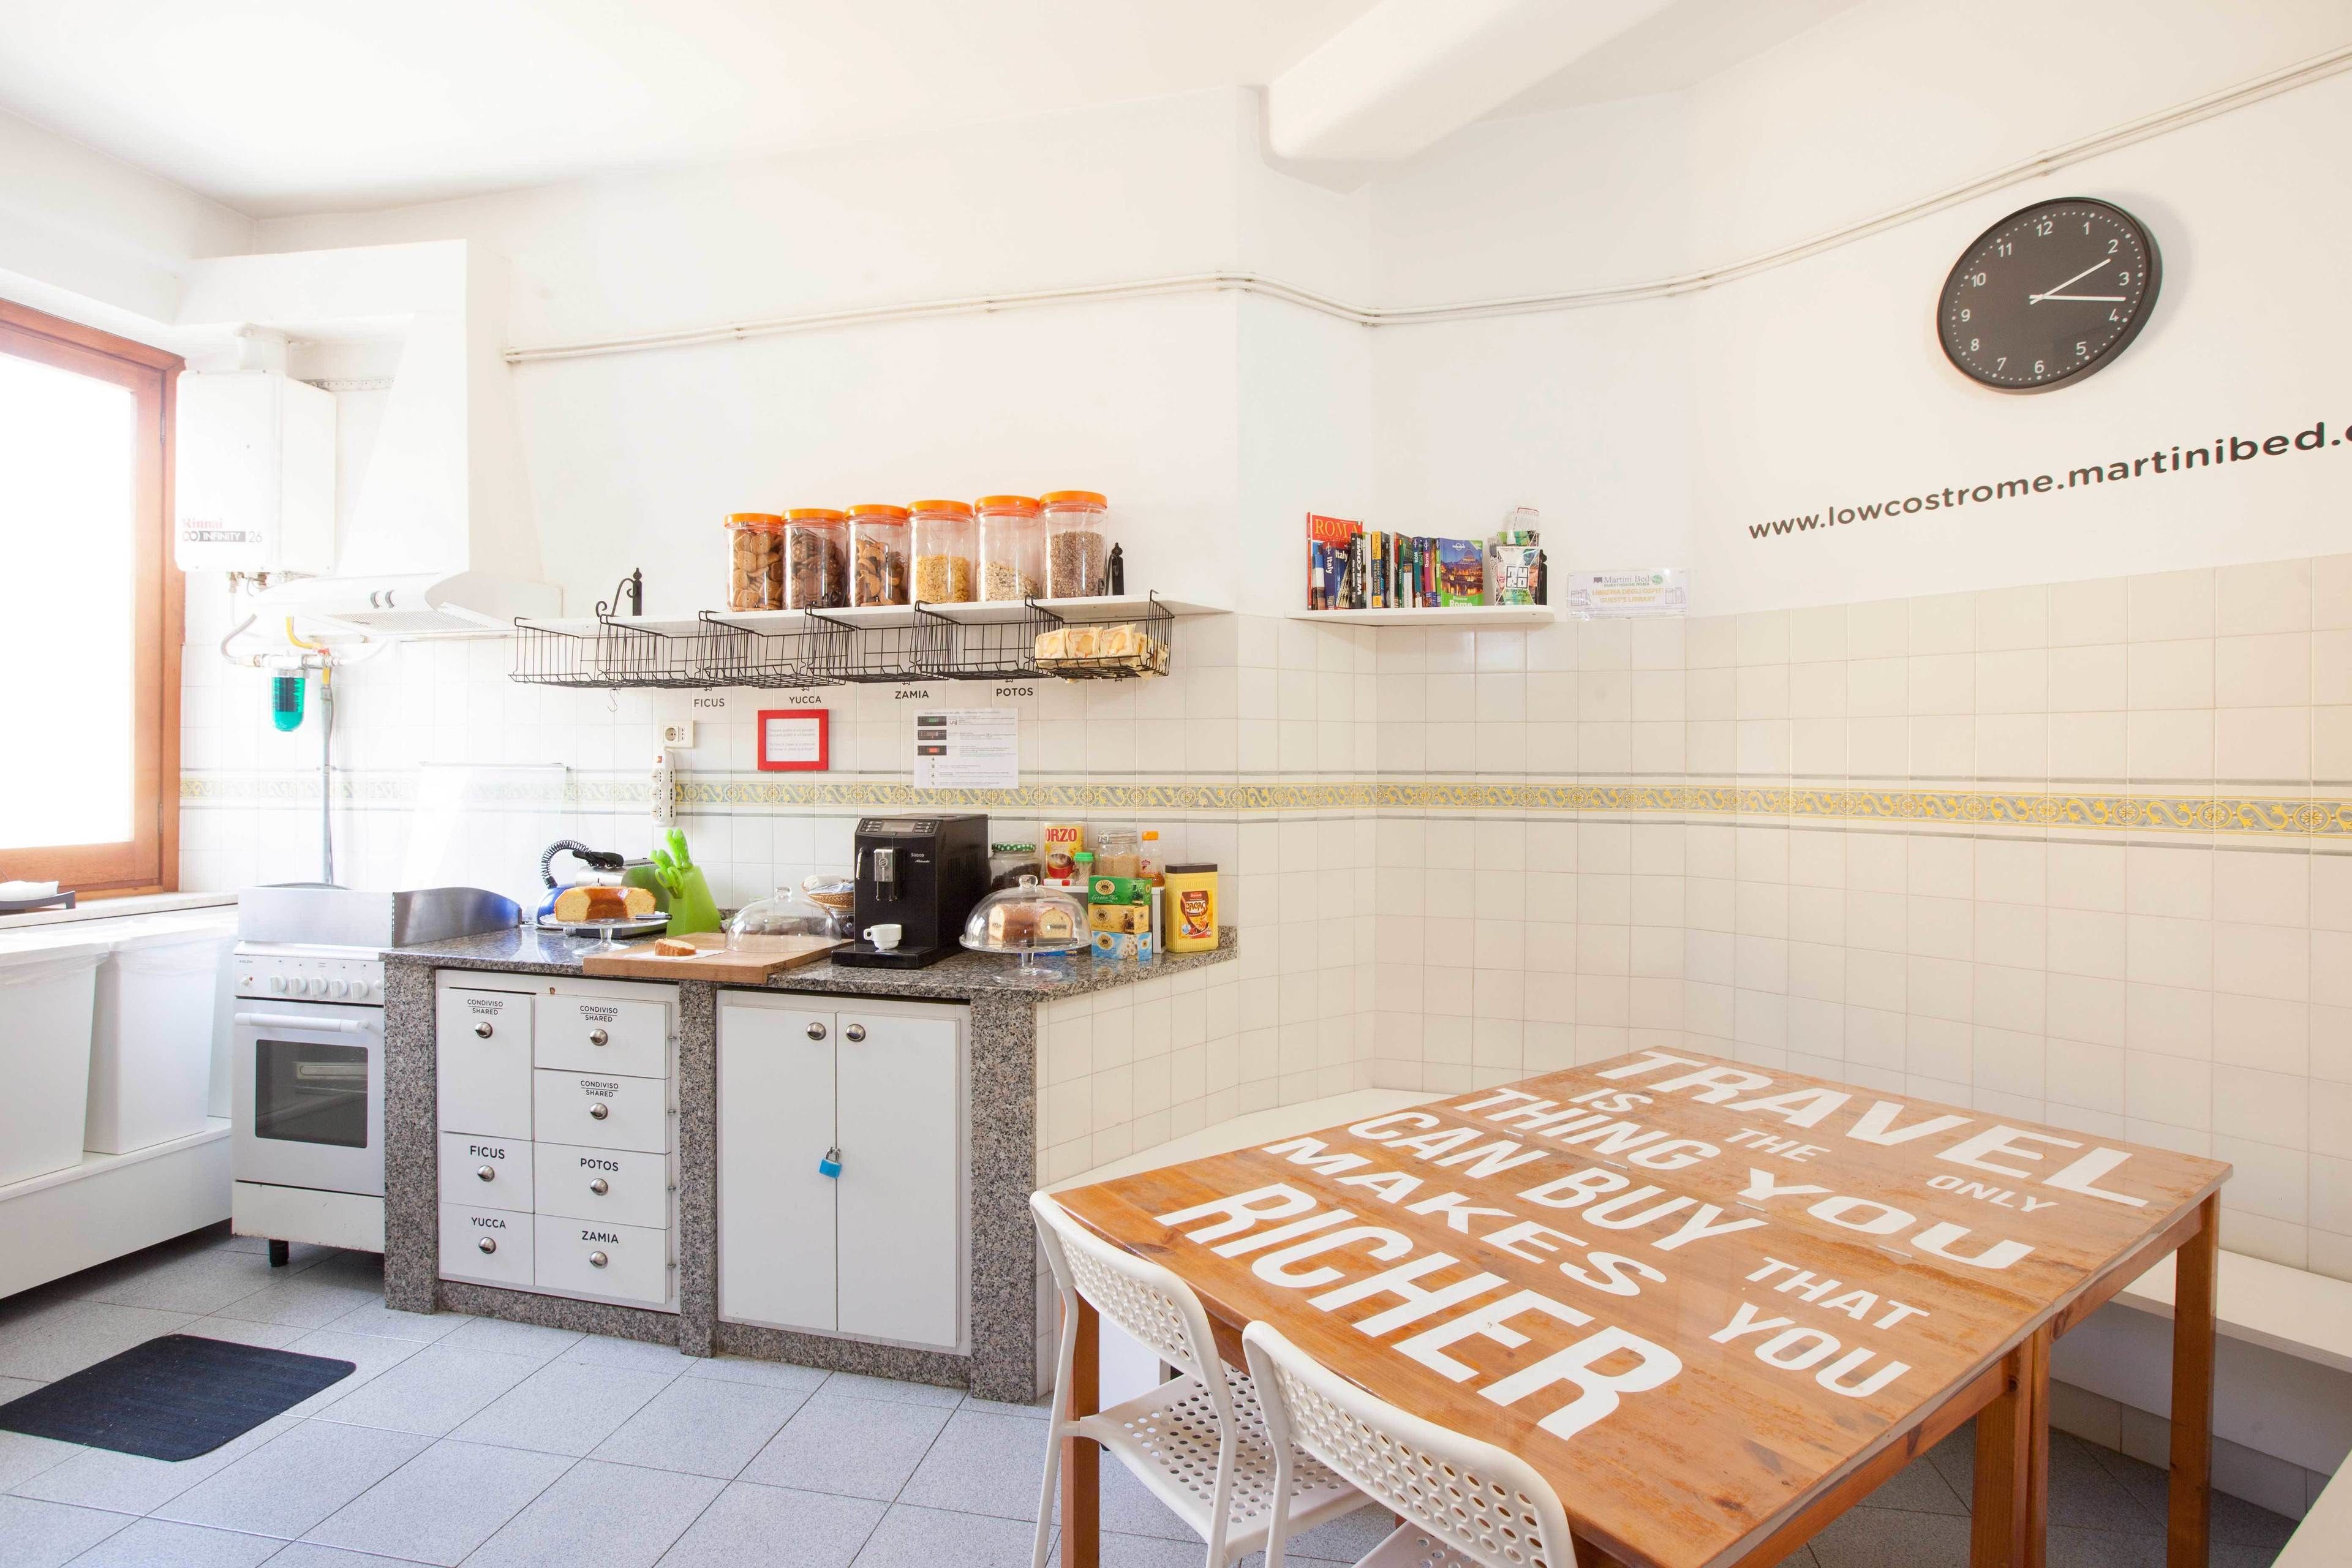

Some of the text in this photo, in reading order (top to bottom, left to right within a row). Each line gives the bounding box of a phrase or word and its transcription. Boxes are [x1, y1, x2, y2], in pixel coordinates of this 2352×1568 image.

[2036, 221, 2053, 236] 12
[2084, 221, 2090, 235] 1
[1998, 243, 2012, 257] 11
[2108, 239, 2119, 254] 2
[1971, 272, 1986, 287] 10
[2119, 271, 2130, 286] 3
[1961, 309, 1970, 322] 9
[2109, 308, 2119, 322] 4
[1970, 338, 1980, 352] 8
[2076, 341, 2087, 355] 5
[1997, 357, 2007, 371] 7
[2034, 360, 2045, 374] 6
[1749, 421, 2352, 539] www.lowcostrome.martinibed.
[183, 517, 224, 529] Rinnai
[203, 531, 263, 543] INFINITY 26
[1335, 550, 1348, 562] Italy
[895, 690, 929, 699] ZAMIA
[996, 687, 1033, 696] POTOS
[694, 698, 725, 707] FICUS
[789, 696, 822, 704] YUCCA
[1186, 902, 1205, 911] CACAO
[579, 1005, 619, 1014] CONDIVISO
[580, 1080, 619, 1089] CONDIVISO
[1596, 1049, 2149, 1208] TRAVEL
[470, 1145, 505, 1159] FICUS
[1569, 1088, 2059, 1213] IS THE ONLY
[580, 1158, 619, 1172] POTOS
[1454, 1088, 2035, 1269] THING YOU
[471, 1216, 507, 1229] YUCCA
[1347, 1112, 1931, 1330] CAN BUY THAT
[581, 1231, 619, 1244] ZAMIA
[1264, 1137, 1912, 1398] MAKES YOU
[1156, 1182, 1683, 1441] RICHER
